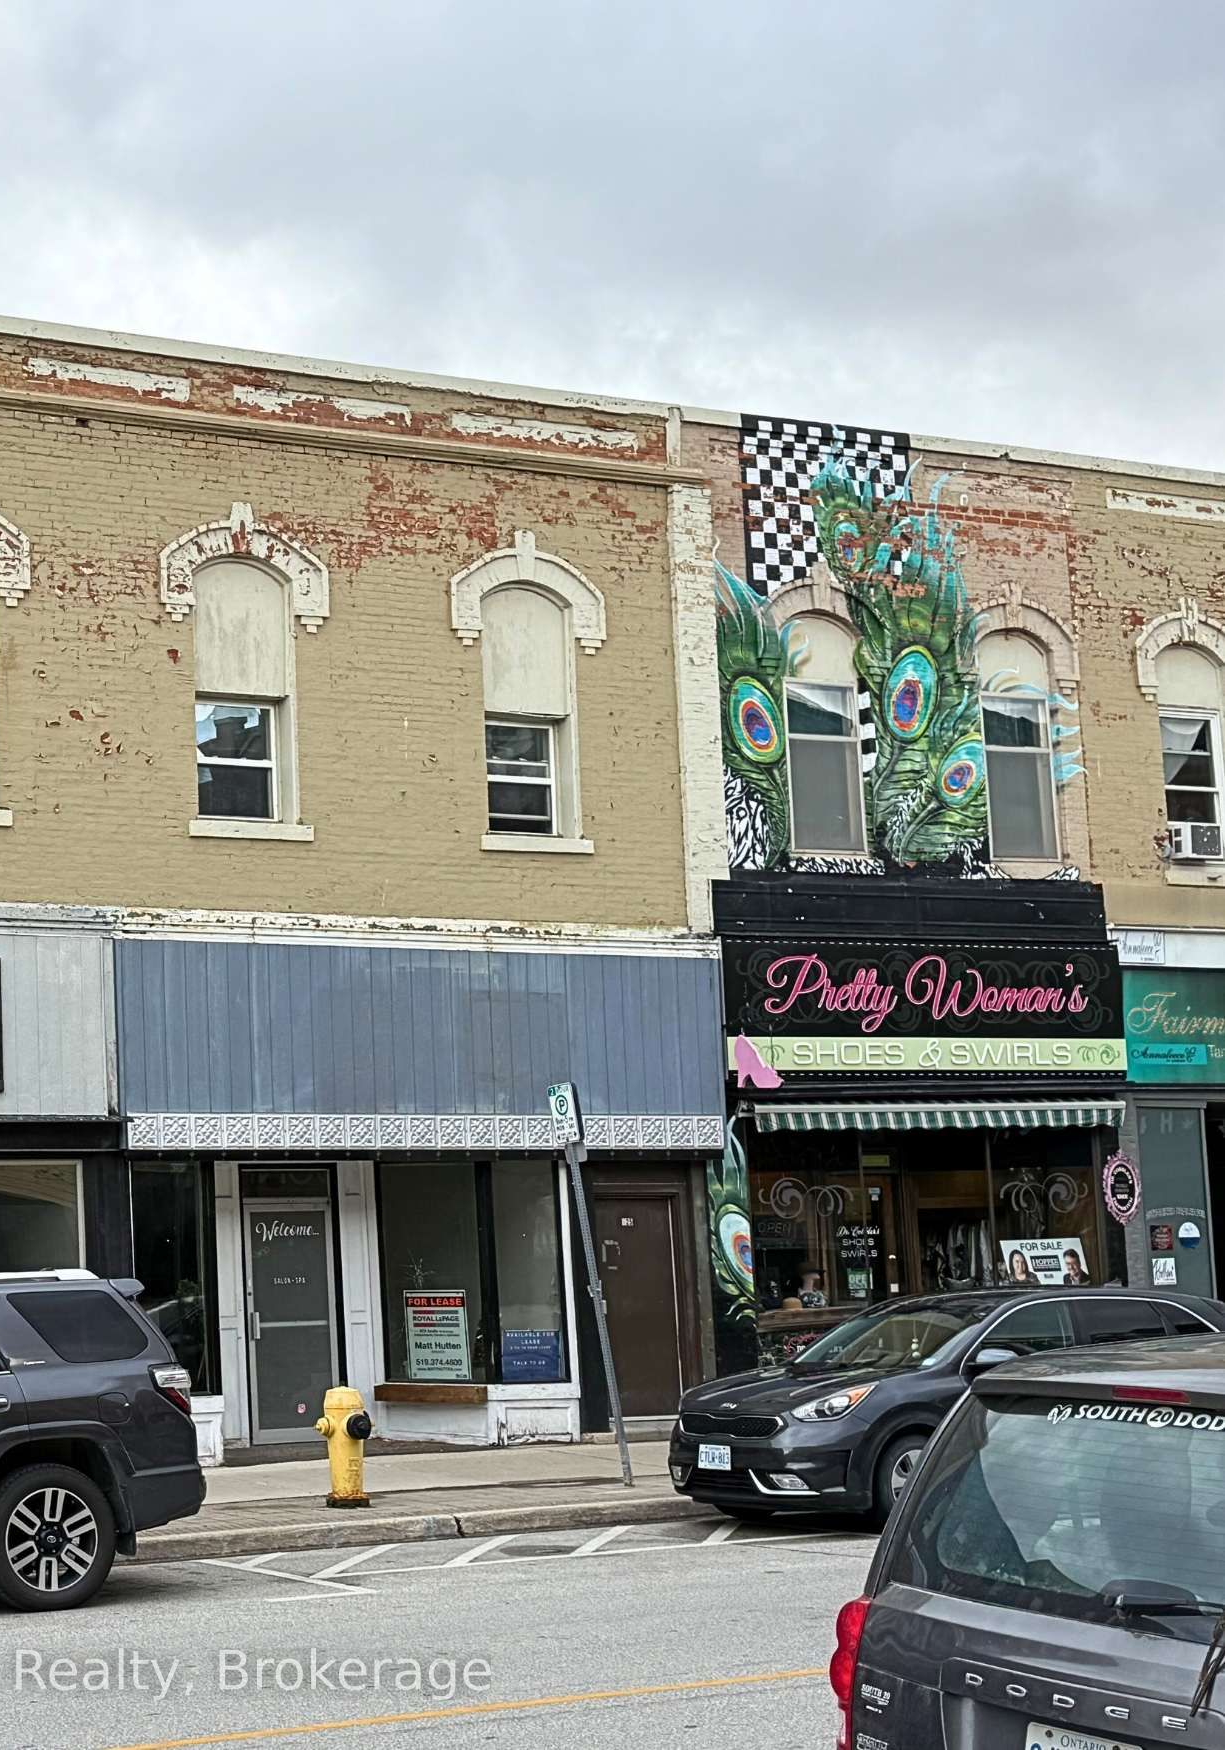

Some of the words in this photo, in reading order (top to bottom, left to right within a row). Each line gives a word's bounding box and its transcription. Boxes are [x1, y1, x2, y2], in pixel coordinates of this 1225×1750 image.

[764, 953, 897, 1032] Pretty
[905, 954, 1089, 1020] Woman's
[792, 1041, 905, 1066] SHOES
[919, 1040, 943, 1069] &
[950, 1042, 1072, 1067] SWIRLS
[1019, 1243, 1038, 1251] FOR
[1040, 1241, 1063, 1250] SALE
[408, 1298, 427, 1306] FOR
[431, 1298, 462, 1306] LEASE
[1075, 1404, 1147, 1422] SOUTH
[1149, 1408, 1171, 1423] 20
[1173, 1411, 1225, 1432] DOD
[965, 1672, 1187, 1731] DODGE
